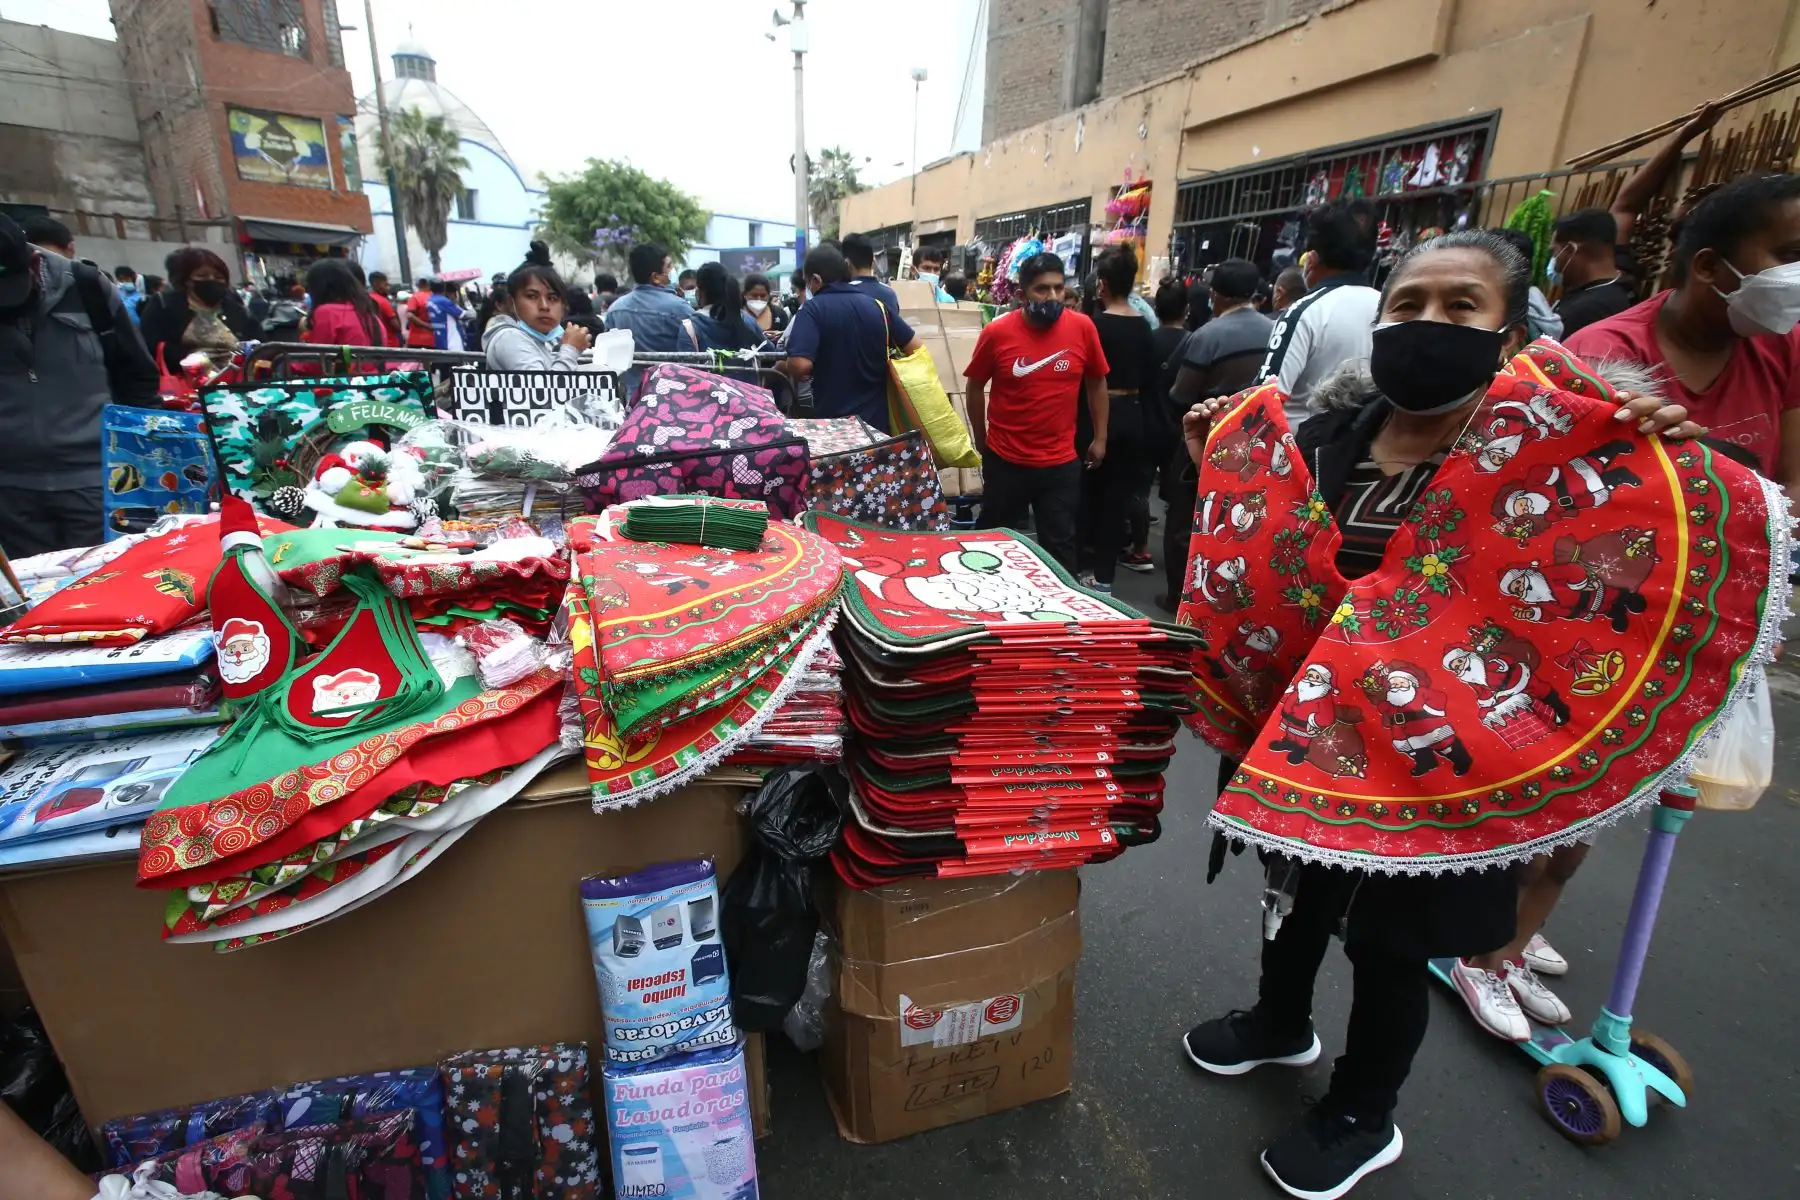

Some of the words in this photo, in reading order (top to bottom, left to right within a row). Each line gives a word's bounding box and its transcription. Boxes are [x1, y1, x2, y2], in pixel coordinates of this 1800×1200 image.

[1053, 360, 1070, 372] SB
[350, 405, 395, 421] FELIZ
[627, 968, 686, 992] Especial
[642, 984, 688, 1004] Jumbo
[615, 1005, 732, 1042] Lavadoras
[608, 1045, 657, 1063] para
[614, 1078, 685, 1102] Funda
[690, 1064, 742, 1096] para
[616, 1089, 745, 1127] Lavadoras
[619, 1183, 666, 1197] JUMBO
